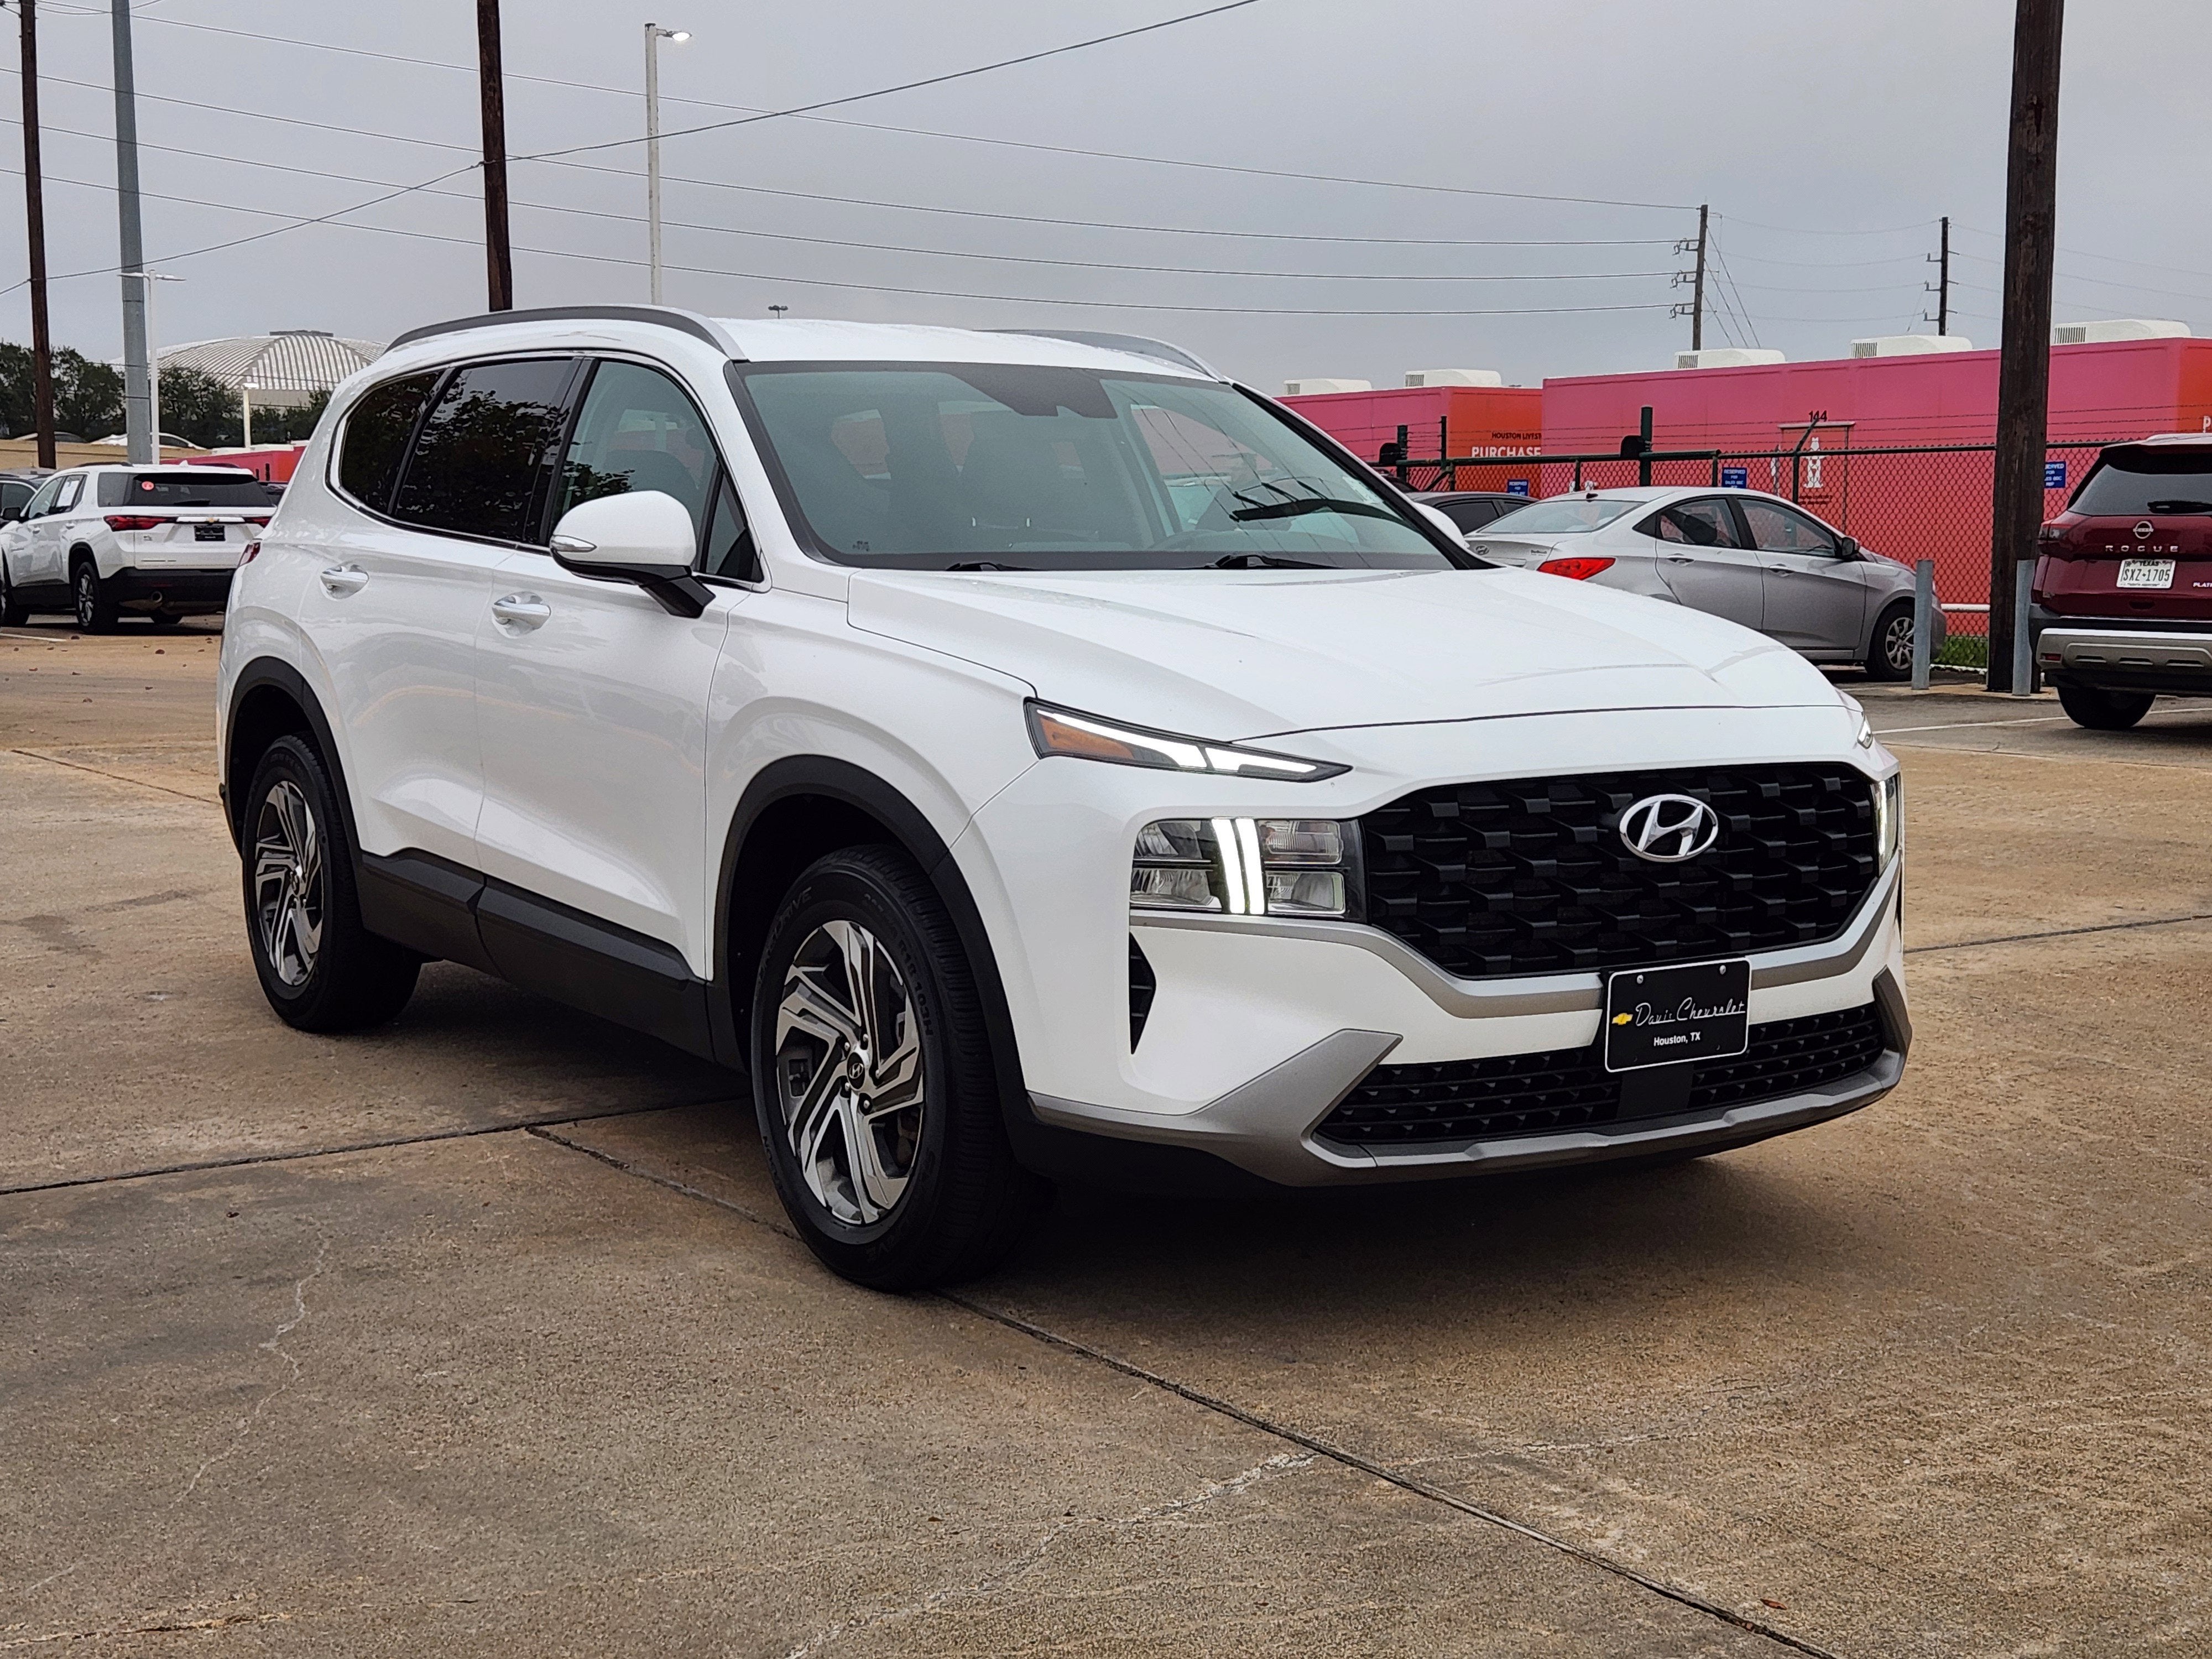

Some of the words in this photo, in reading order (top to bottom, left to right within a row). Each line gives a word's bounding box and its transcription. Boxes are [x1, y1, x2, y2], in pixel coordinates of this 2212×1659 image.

[1809, 410, 1827, 422] 144
[1472, 446, 1541, 458] PURCHASE
[1635, 1002, 1676, 1026] Davis
[1676, 997, 1746, 1021] Chevrolet
[1653, 1035, 1688, 1046] Houston,
[1689, 1031, 1701, 1042] TX
